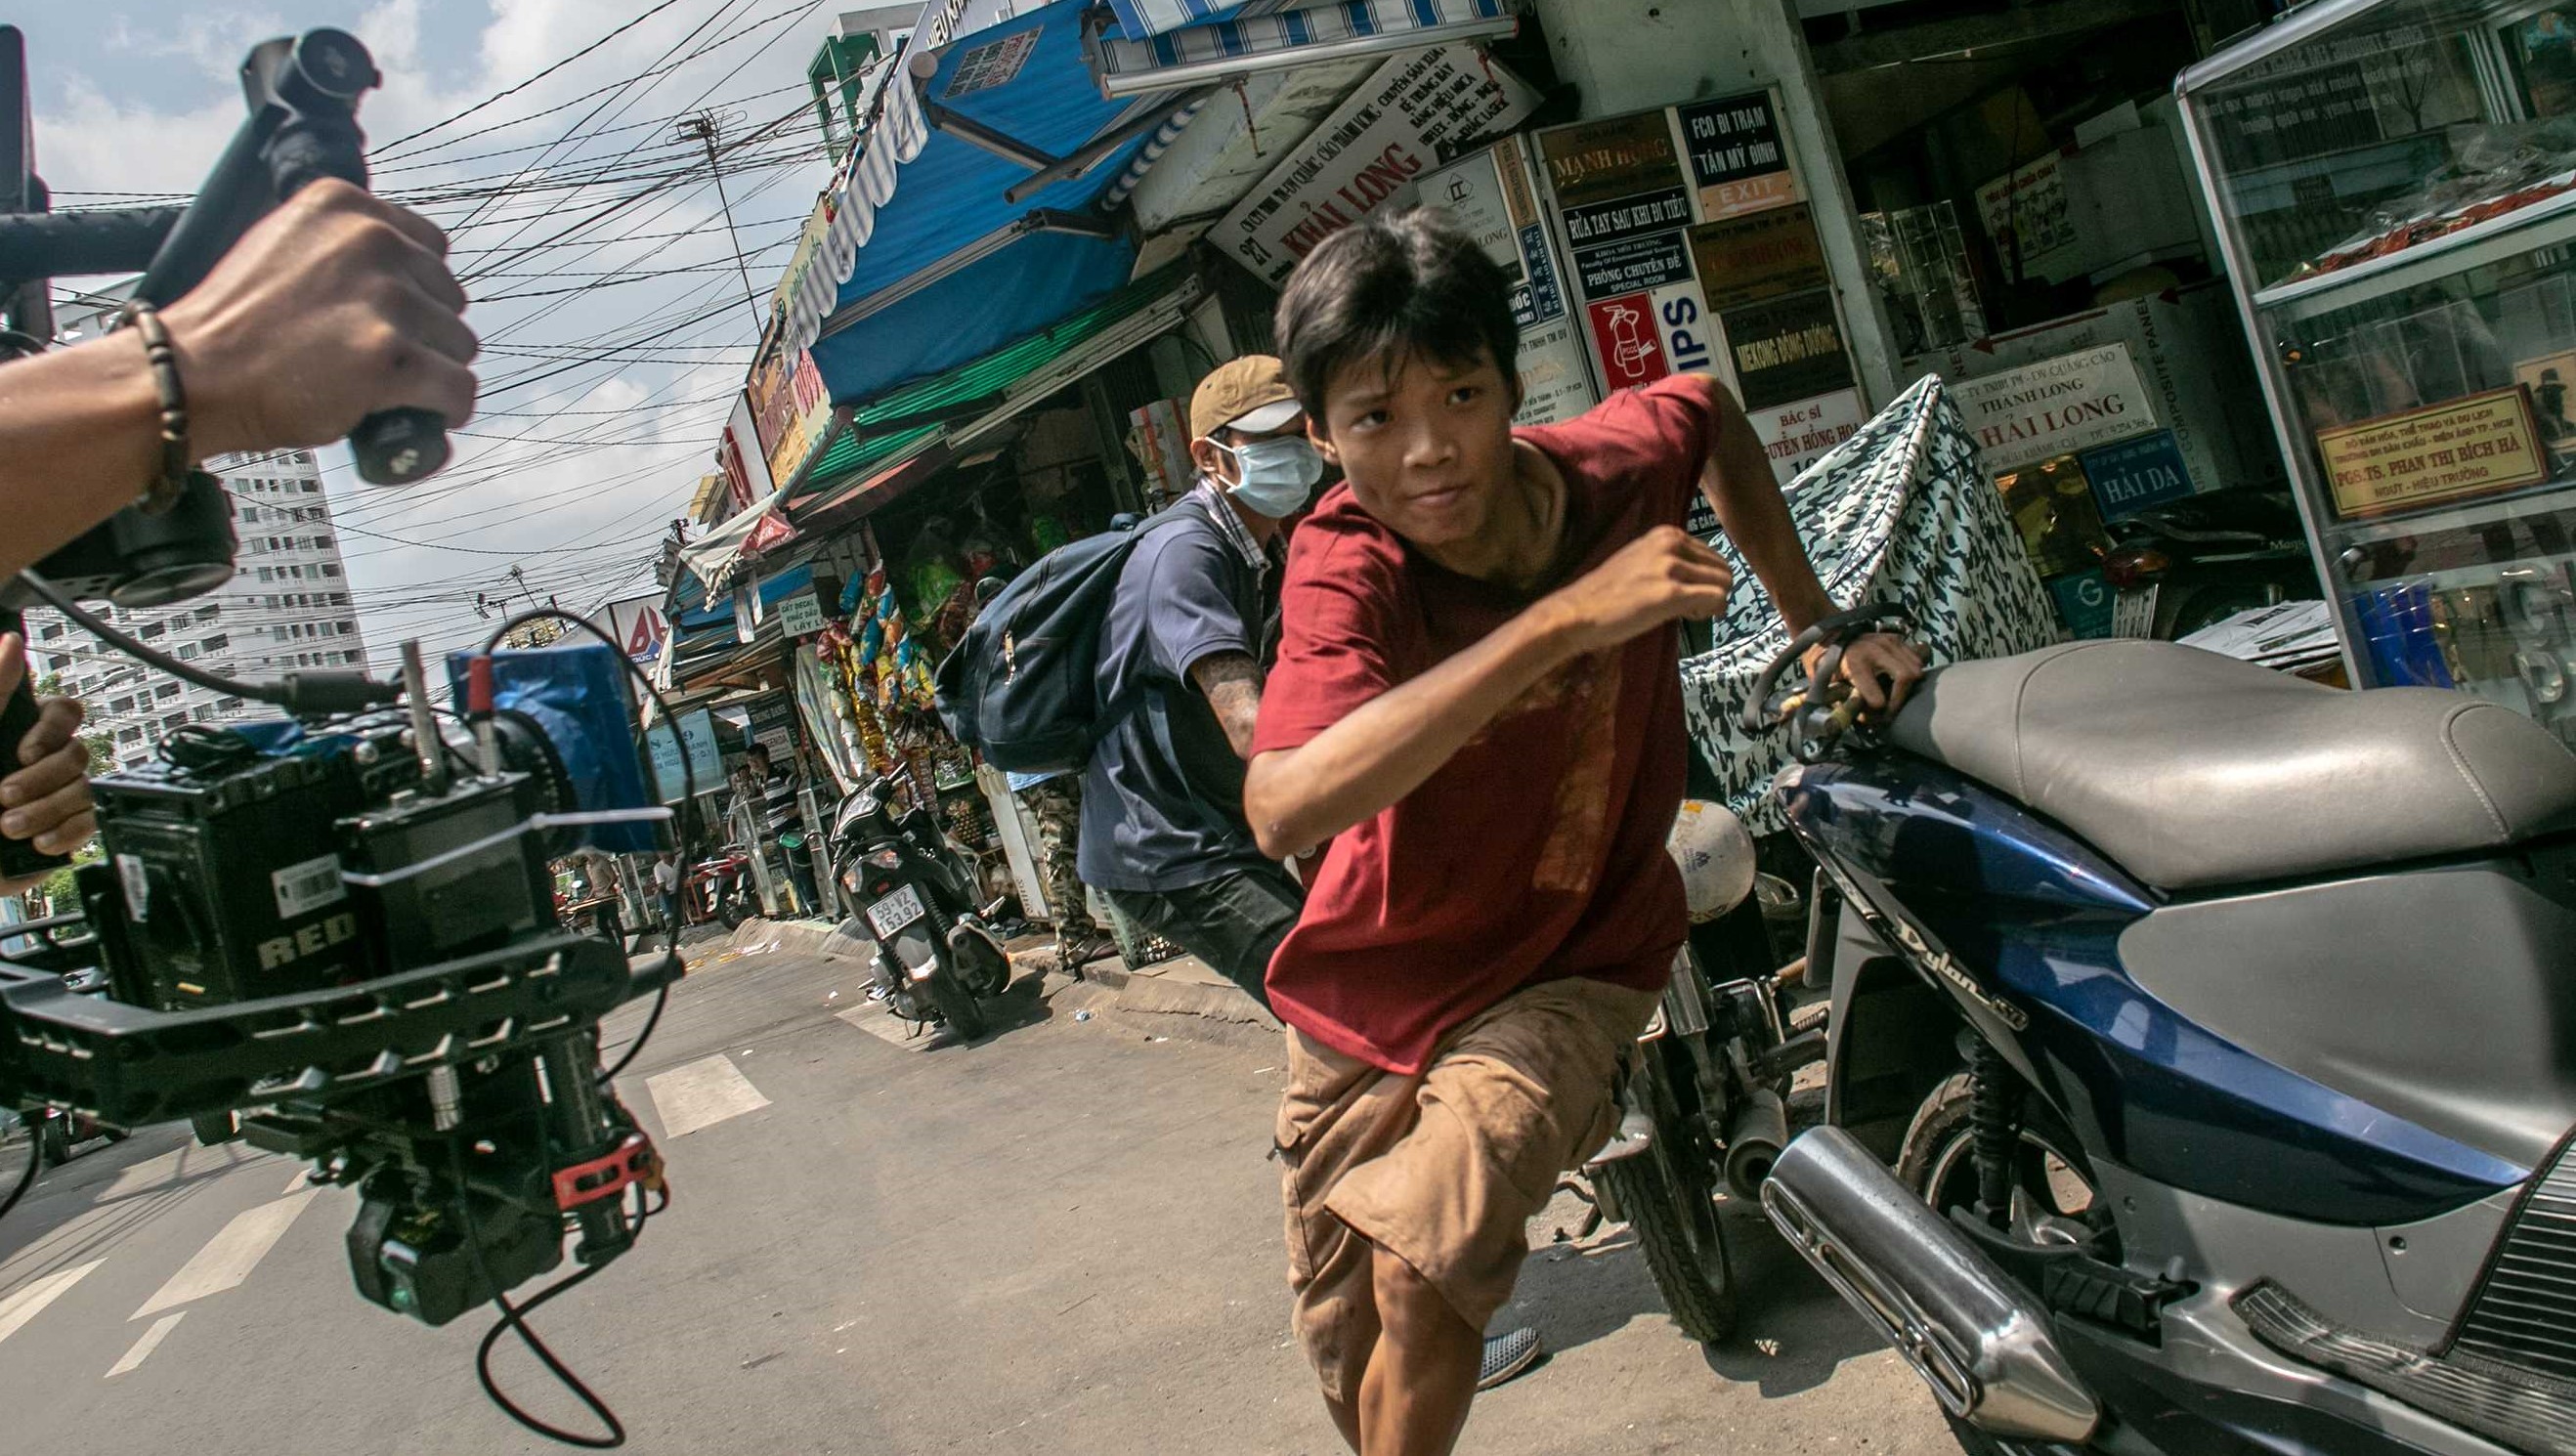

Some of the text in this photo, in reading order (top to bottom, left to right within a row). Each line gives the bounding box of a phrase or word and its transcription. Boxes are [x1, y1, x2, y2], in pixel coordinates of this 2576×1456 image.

[1377, 75, 1411, 107] CHUYÊN
[1405, 62, 1427, 81] SẢN
[1450, 73, 1477, 95] MICA
[1692, 107, 1767, 140] FCO ĐI TRẠM
[1554, 150, 1611, 178] MẠNH
[1698, 148, 1727, 175] TÂN
[1727, 143, 1745, 170] MỸ
[1279, 142, 1423, 259] KHẢI LONG
[1720, 178, 1777, 203] EXIT
[1568, 211, 1593, 239] RỬA
[1590, 212, 1611, 235] TAY
[1611, 208, 1631, 231] SAU
[1631, 204, 1652, 227] KHI
[1650, 201, 1664, 222] ĐI
[1239, 236, 1271, 266] 27
[1587, 268, 1622, 286] PHÒNG
[1624, 258, 1665, 278] CHUYÊN
[1610, 279, 1643, 293] SPECIAL
[1663, 296, 1710, 370] IPS
[2090, 351, 2116, 365] CÁO
[2133, 294, 2193, 453] COMPOSITE PANEL
[1978, 379, 2083, 414] THÀNH LONG
[2043, 394, 2125, 431] LONG
[2418, 420, 2442, 432] THAO
[2443, 417, 2456, 427] VÀ
[2457, 414, 2470, 424] DU
[2472, 408, 2494, 421] LỊCH
[1762, 431, 1800, 461] UYỄN
[2336, 432, 2521, 488] PGS.TS. PHAN THỊ BÍCH HÀ
[2103, 467, 2146, 503] HẢI
[2147, 465, 2180, 491] DA
[2412, 476, 2439, 491] HIỆU
[2440, 466, 2489, 485] TRƯỜNG
[873, 891, 913, 920] 59-V2
[258, 912, 356, 970] RED
[1897, 915, 1984, 998] Dylan
